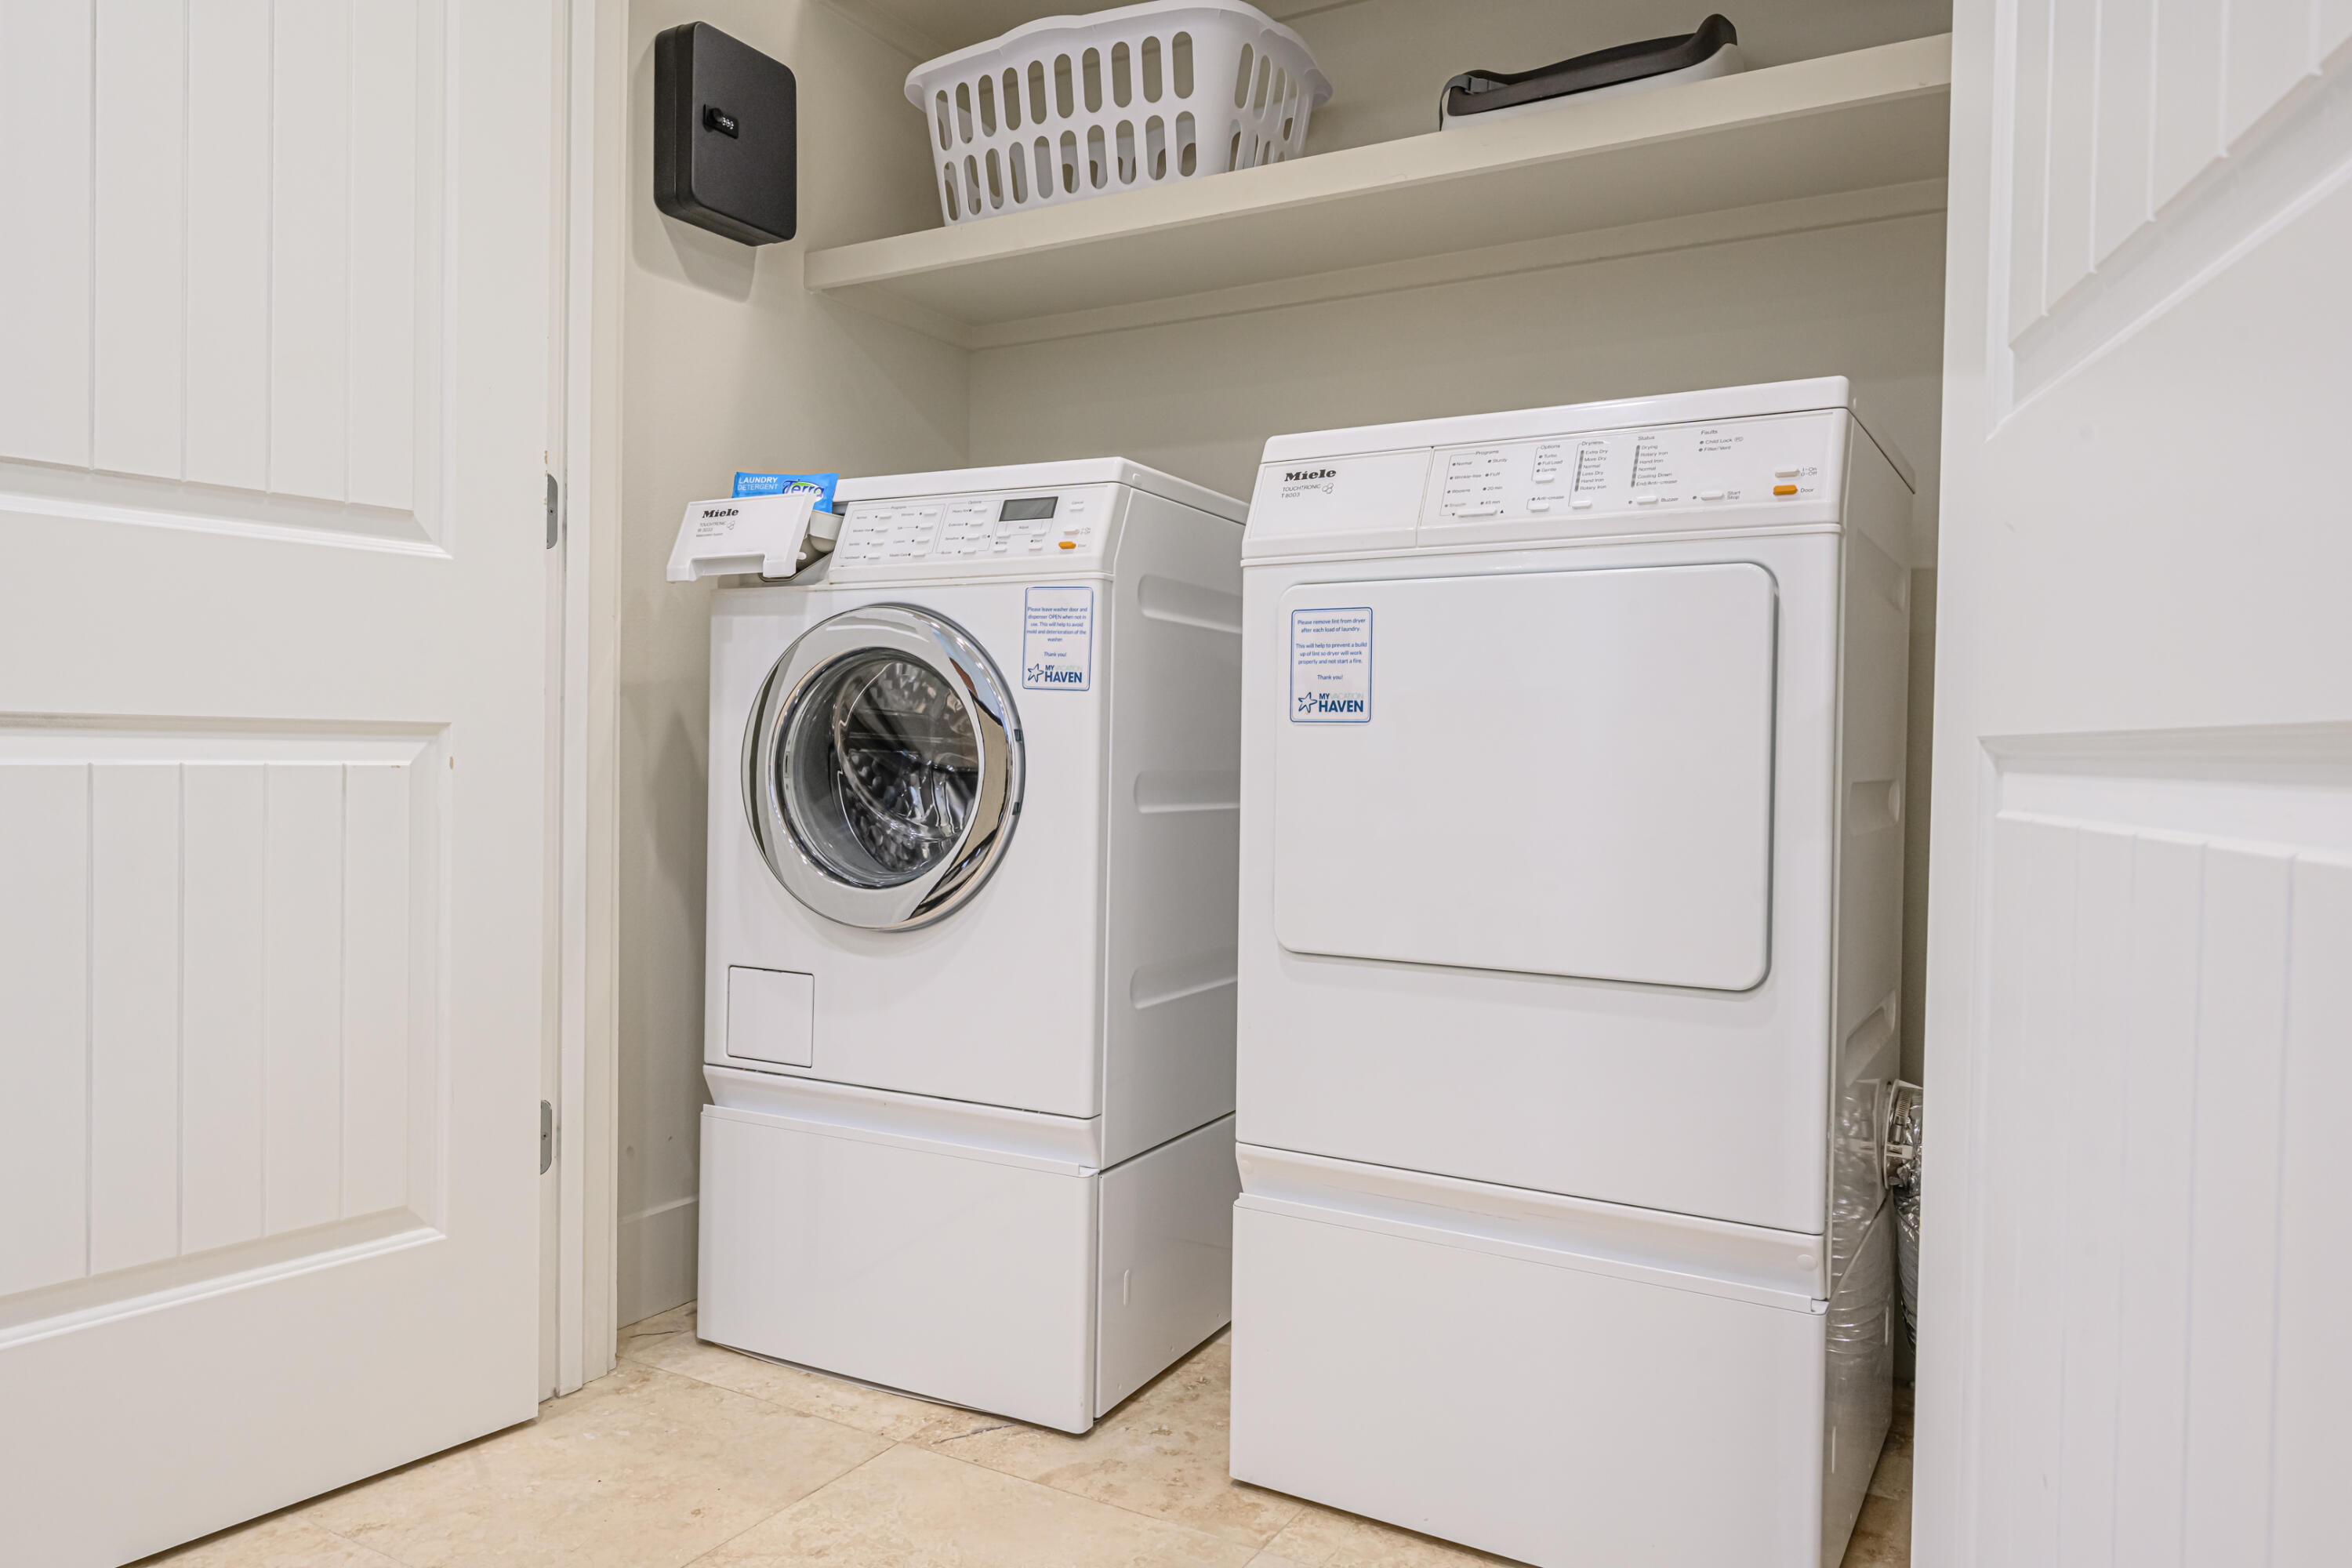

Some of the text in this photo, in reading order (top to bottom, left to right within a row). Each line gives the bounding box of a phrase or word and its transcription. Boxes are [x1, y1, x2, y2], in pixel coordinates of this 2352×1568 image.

[1284, 469, 1337, 482] Miele
[782, 478, 825, 498] Terra
[702, 508, 739, 518] Miele
[1044, 671, 1083, 683] HAVEN
[1318, 699, 1364, 713] HAVEN
